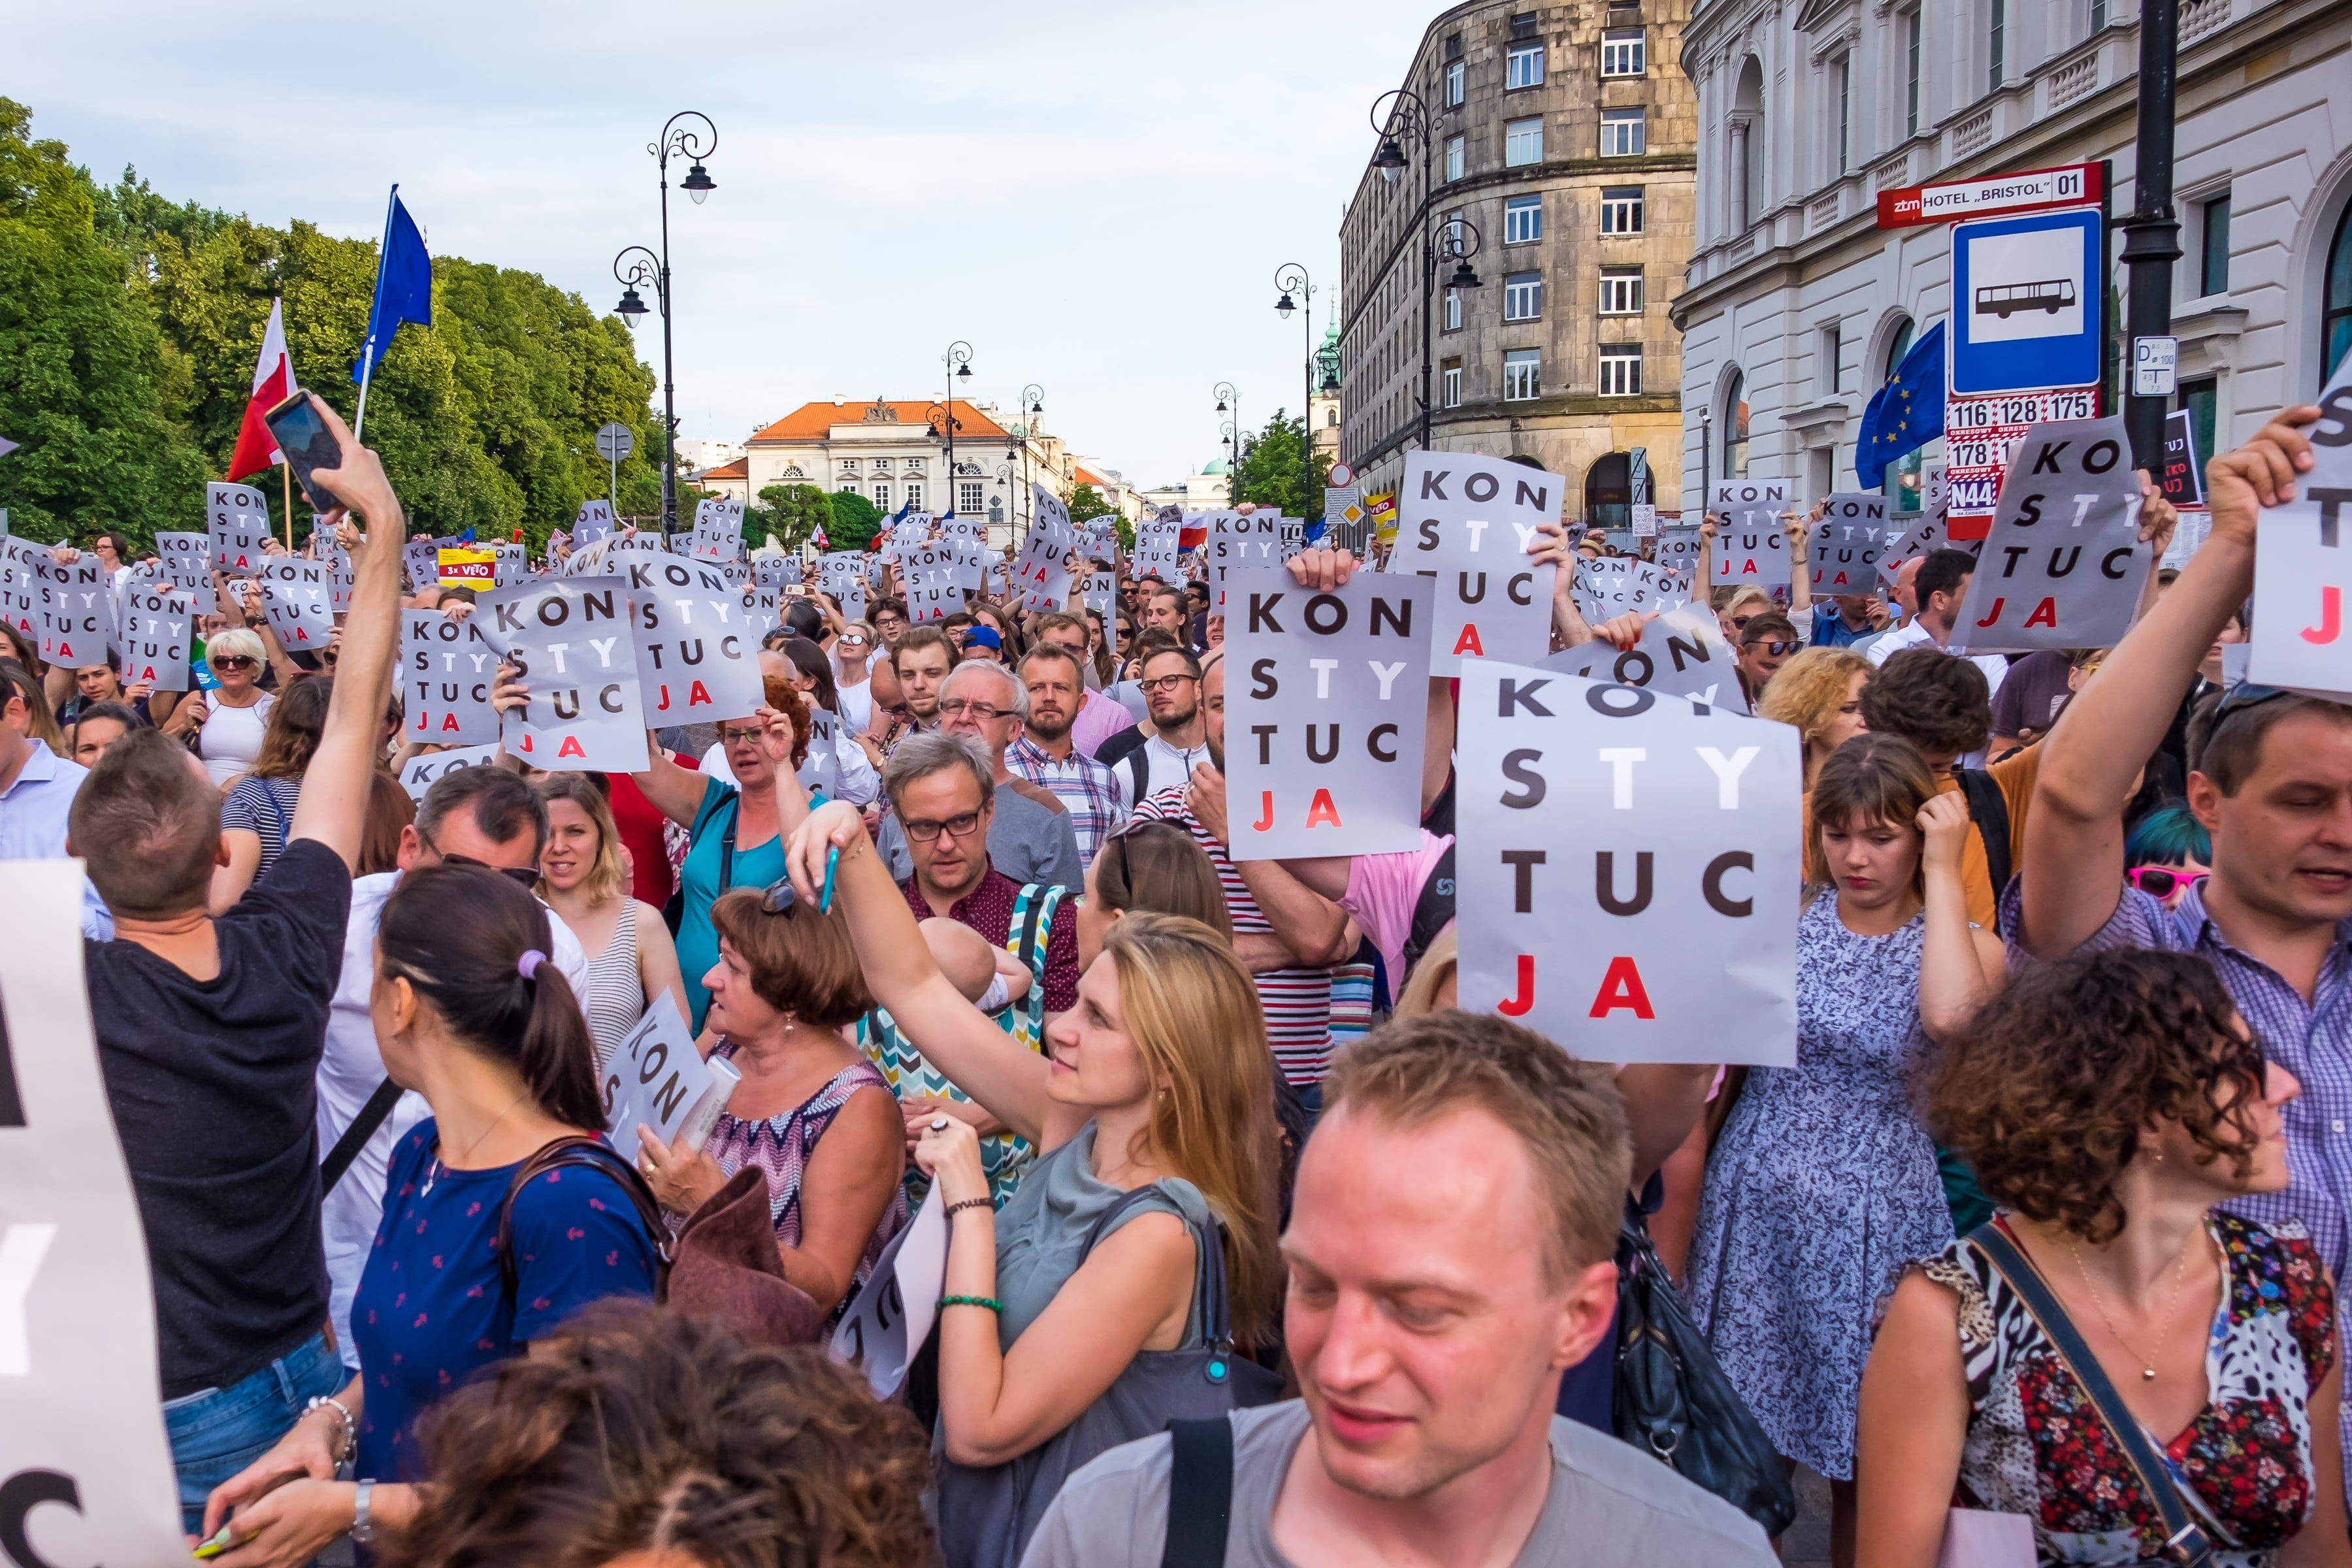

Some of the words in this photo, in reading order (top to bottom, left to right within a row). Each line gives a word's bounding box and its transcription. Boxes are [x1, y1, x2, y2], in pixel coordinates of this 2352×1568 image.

[2058, 174, 2078, 195] 01
[1895, 199, 1919, 213] ztm
[1924, 193, 1969, 208] HOTEL
[2138, 346, 2150, 361] D
[2161, 355, 2174, 365] 100
[1955, 404, 1987, 427] 116
[2001, 400, 2037, 423] 128
[2051, 395, 2087, 419] 175
[2165, 438, 2183, 452] UJ
[1953, 444, 1987, 466] 178
[2032, 439, 2136, 474] KO
[1950, 466, 1991, 475] OKRESOWY
[1421, 470, 1548, 512] KON
[1718, 486, 1783, 503] KON
[1951, 482, 1993, 508] N44
[216, 492, 264, 510] KON
[703, 502, 740, 515] KON
[1037, 491, 1068, 525] KON
[1369, 502, 1389, 514] VETO
[578, 508, 608, 522] ON
[1720, 510, 1782, 527] STY
[1823, 501, 1884, 519] KON
[2013, 493, 2144, 528] STY
[218, 513, 266, 530] STY
[700, 515, 738, 530] STY
[945, 524, 982, 536] KON
[1038, 514, 1070, 544] STY
[1141, 524, 1177, 534] KON
[1216, 517, 1273, 533] KON
[580, 527, 610, 542] TY
[700, 529, 735, 544] TUC
[892, 527, 925, 536] STY
[1416, 519, 1537, 554] STY
[1819, 525, 1882, 542] STY
[163, 539, 208, 551] KON
[696, 544, 719, 557] JA
[1141, 537, 1175, 548] STY
[1217, 541, 1273, 558] STY
[1661, 542, 1701, 553] KON
[1721, 534, 1781, 551] TUC
[219, 553, 249, 568] JA
[495, 549, 520, 560] ON
[908, 549, 952, 566] KON
[1032, 538, 1073, 566] TUC
[1140, 551, 1172, 562] TUC
[1817, 547, 1875, 564] TUC
[168, 557, 207, 570] STY
[332, 557, 351, 569] ST
[416, 560, 436, 576] ST
[461, 564, 489, 576] VETO
[496, 564, 519, 573] TY
[760, 559, 795, 568] KON
[821, 561, 860, 573] KON
[1137, 566, 1159, 576] JA
[1720, 558, 1759, 576] JA
[2002, 545, 2134, 580] TUC
[4, 568, 31, 588] ST
[35, 563, 97, 583] KON
[261, 564, 319, 583] KON
[333, 574, 355, 585] TU
[630, 563, 725, 592] KON
[724, 567, 747, 580] ON
[762, 572, 796, 583] STY
[912, 567, 953, 585] STY
[1020, 561, 1047, 583] JA
[1812, 570, 1848, 585] JA
[172, 575, 208, 588] TUC
[231, 582, 249, 593] KO
[823, 576, 860, 587] STY
[1081, 579, 1109, 591] ON
[1592, 578, 1626, 588] TY
[1640, 570, 1690, 593] KON
[3, 591, 30, 611] TU
[42, 588, 97, 610] STY
[263, 585, 319, 600] STY
[742, 594, 774, 608] ON
[838, 591, 859, 602] UC
[913, 586, 956, 603] TUC
[1593, 589, 1624, 602] UC
[1632, 589, 1686, 611] STY
[131, 593, 186, 615] KON
[1030, 595, 1053, 608] JA
[1083, 598, 1109, 610] TY
[271, 603, 323, 621] TUC
[495, 590, 615, 633] KON
[643, 600, 729, 630] STY
[917, 606, 944, 621] JA
[1249, 593, 1413, 638] KON
[1976, 597, 2057, 629] JA
[43, 612, 97, 634] TUC
[129, 617, 183, 638] STY
[743, 615, 774, 630] TY
[283, 627, 310, 644] JA
[1452, 623, 1484, 656] A
[45, 638, 74, 658] JA
[128, 639, 180, 661] TUC
[647, 636, 742, 670] TUC
[416, 651, 487, 673] STY
[506, 637, 618, 678] STY
[1578, 627, 1711, 687] ON
[127, 662, 157, 681] JA
[1250, 659, 1408, 700] STY
[416, 681, 487, 704] TUC
[657, 680, 713, 711] JA
[417, 711, 461, 732] JA
[519, 734, 587, 758] JA
[1250, 723, 1399, 764] TUC
[1499, 745, 1762, 809] STY
[1252, 789, 1343, 832] JA
[1501, 850, 1755, 917] TUC
[1497, 954, 1656, 1020] JA
[629, 1015, 688, 1126] KON
